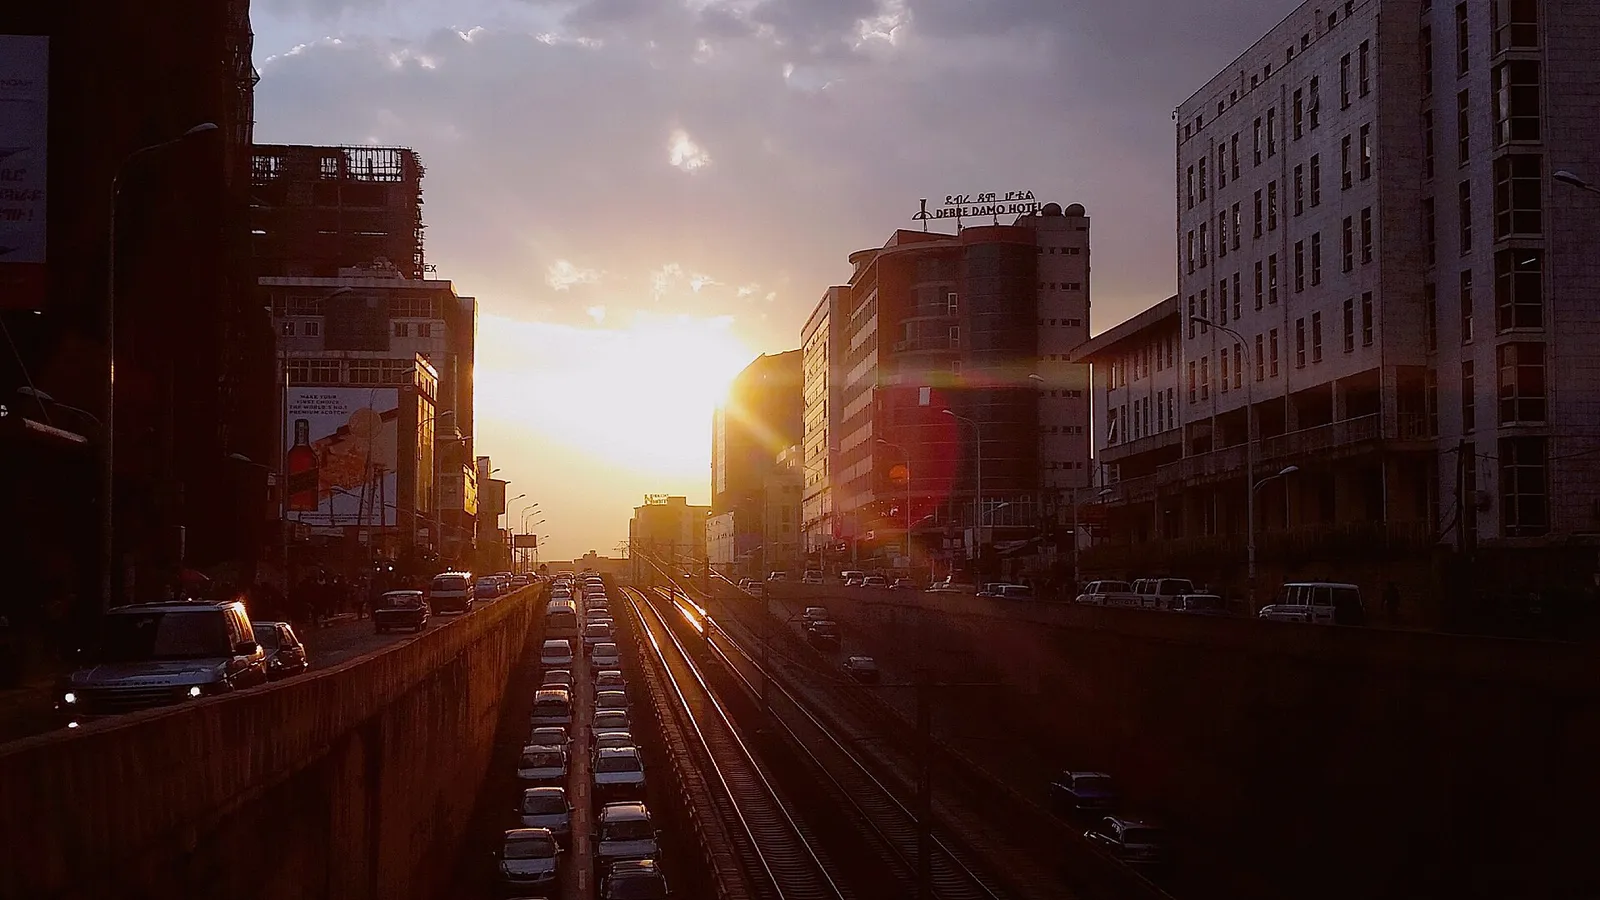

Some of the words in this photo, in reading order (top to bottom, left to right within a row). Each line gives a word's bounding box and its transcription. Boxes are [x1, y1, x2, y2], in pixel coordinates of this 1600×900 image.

[936, 206, 969, 219] DEBRE
[972, 204, 1006, 216] DAMO
[1009, 202, 1041, 214] HOTEL
[424, 264, 437, 273] EX
